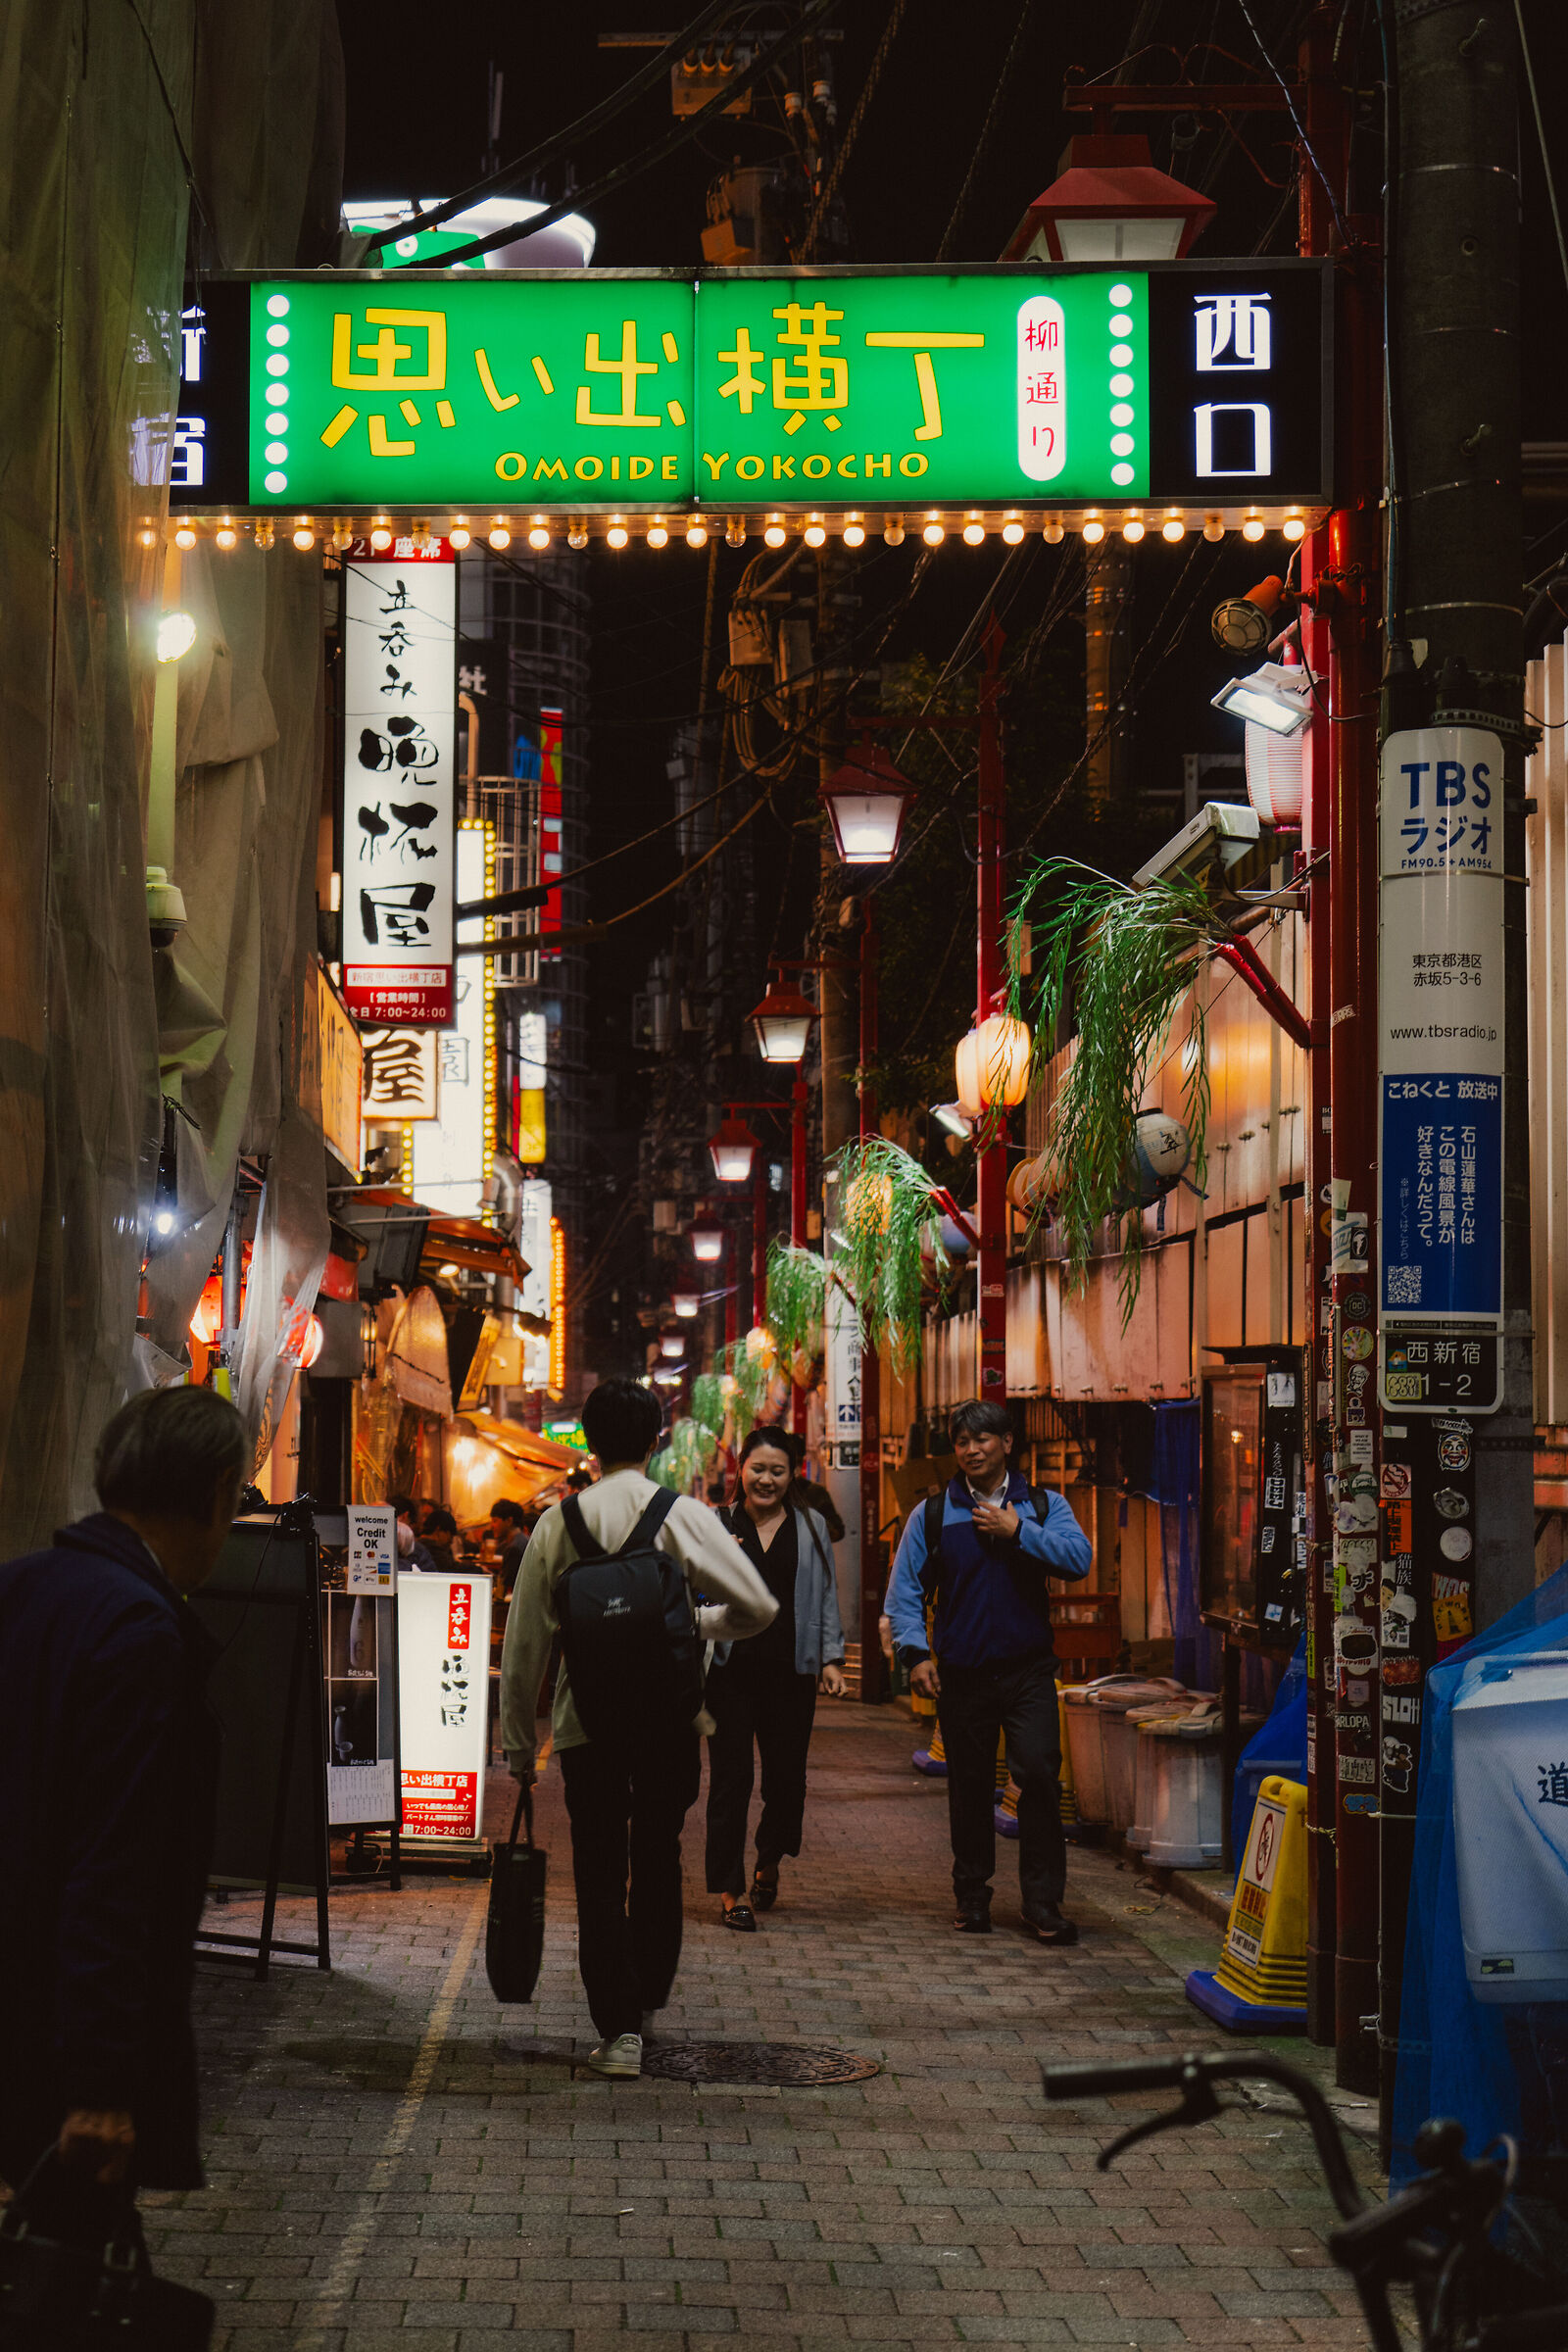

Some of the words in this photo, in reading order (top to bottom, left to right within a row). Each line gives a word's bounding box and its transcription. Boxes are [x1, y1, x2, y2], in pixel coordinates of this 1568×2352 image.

[319, 301, 985, 458] 思い出横丁
[1024, 318, 1059, 458] 柳通り
[1193, 292, 1272, 477] 西口
[494, 453, 678, 482] OMOIDE
[703, 452, 930, 481] YOKOCHO
[378, 579, 416, 701] 立呑み
[1400, 760, 1492, 809] TBS
[357, 715, 439, 948] 晩杯屋
[1400, 815, 1492, 855] ラジオ
[1412, 953, 1483, 969] 東京都港区
[1413, 971, 1482, 987] 赤坂5-3-6
[375, 1006, 446, 1018] 7:00~24:00
[1390, 1024, 1497, 1042] www.tbsradio.jp
[363, 1030, 424, 1103] 屋
[1388, 1080, 1451, 1100] こねくと
[1457, 1080, 1498, 1101] 放送中
[1417, 1126, 1435, 1248] 好きなんだって。
[1438, 1126, 1456, 1245] この電線風景が
[1460, 1126, 1476, 1246] 石山蓮華さんは
[1406, 1340, 1482, 1365] 西新宿
[354, 1515, 389, 1525] welcome
[357, 1528, 386, 1539] Credit
[364, 1539, 378, 1549] OK
[1537, 1761, 1568, 1808] 道
[415, 1825, 471, 1837] 7:00~24:00
